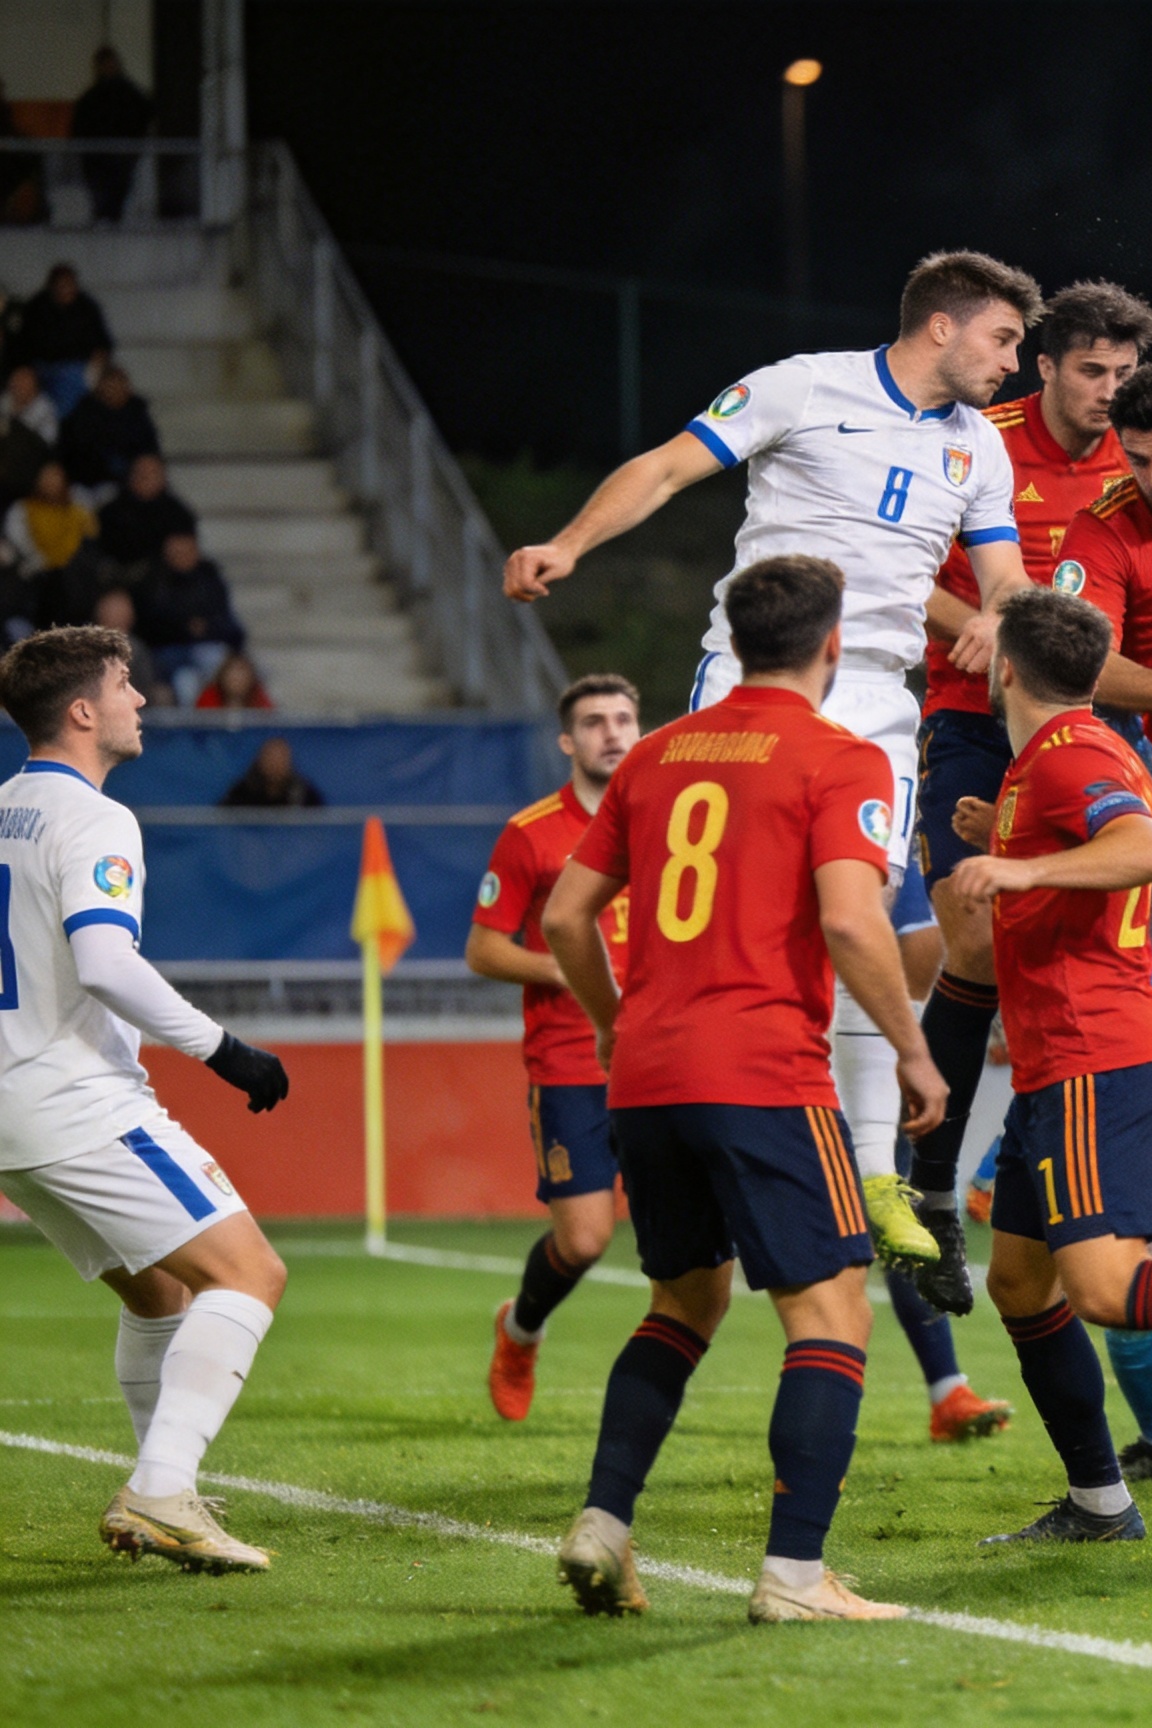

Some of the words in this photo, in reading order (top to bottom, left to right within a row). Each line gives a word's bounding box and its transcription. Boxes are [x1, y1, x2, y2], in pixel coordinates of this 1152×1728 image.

[877, 466, 913, 523] 8
[656, 781, 729, 942] 8
[1037, 1157, 1064, 1226] 1
